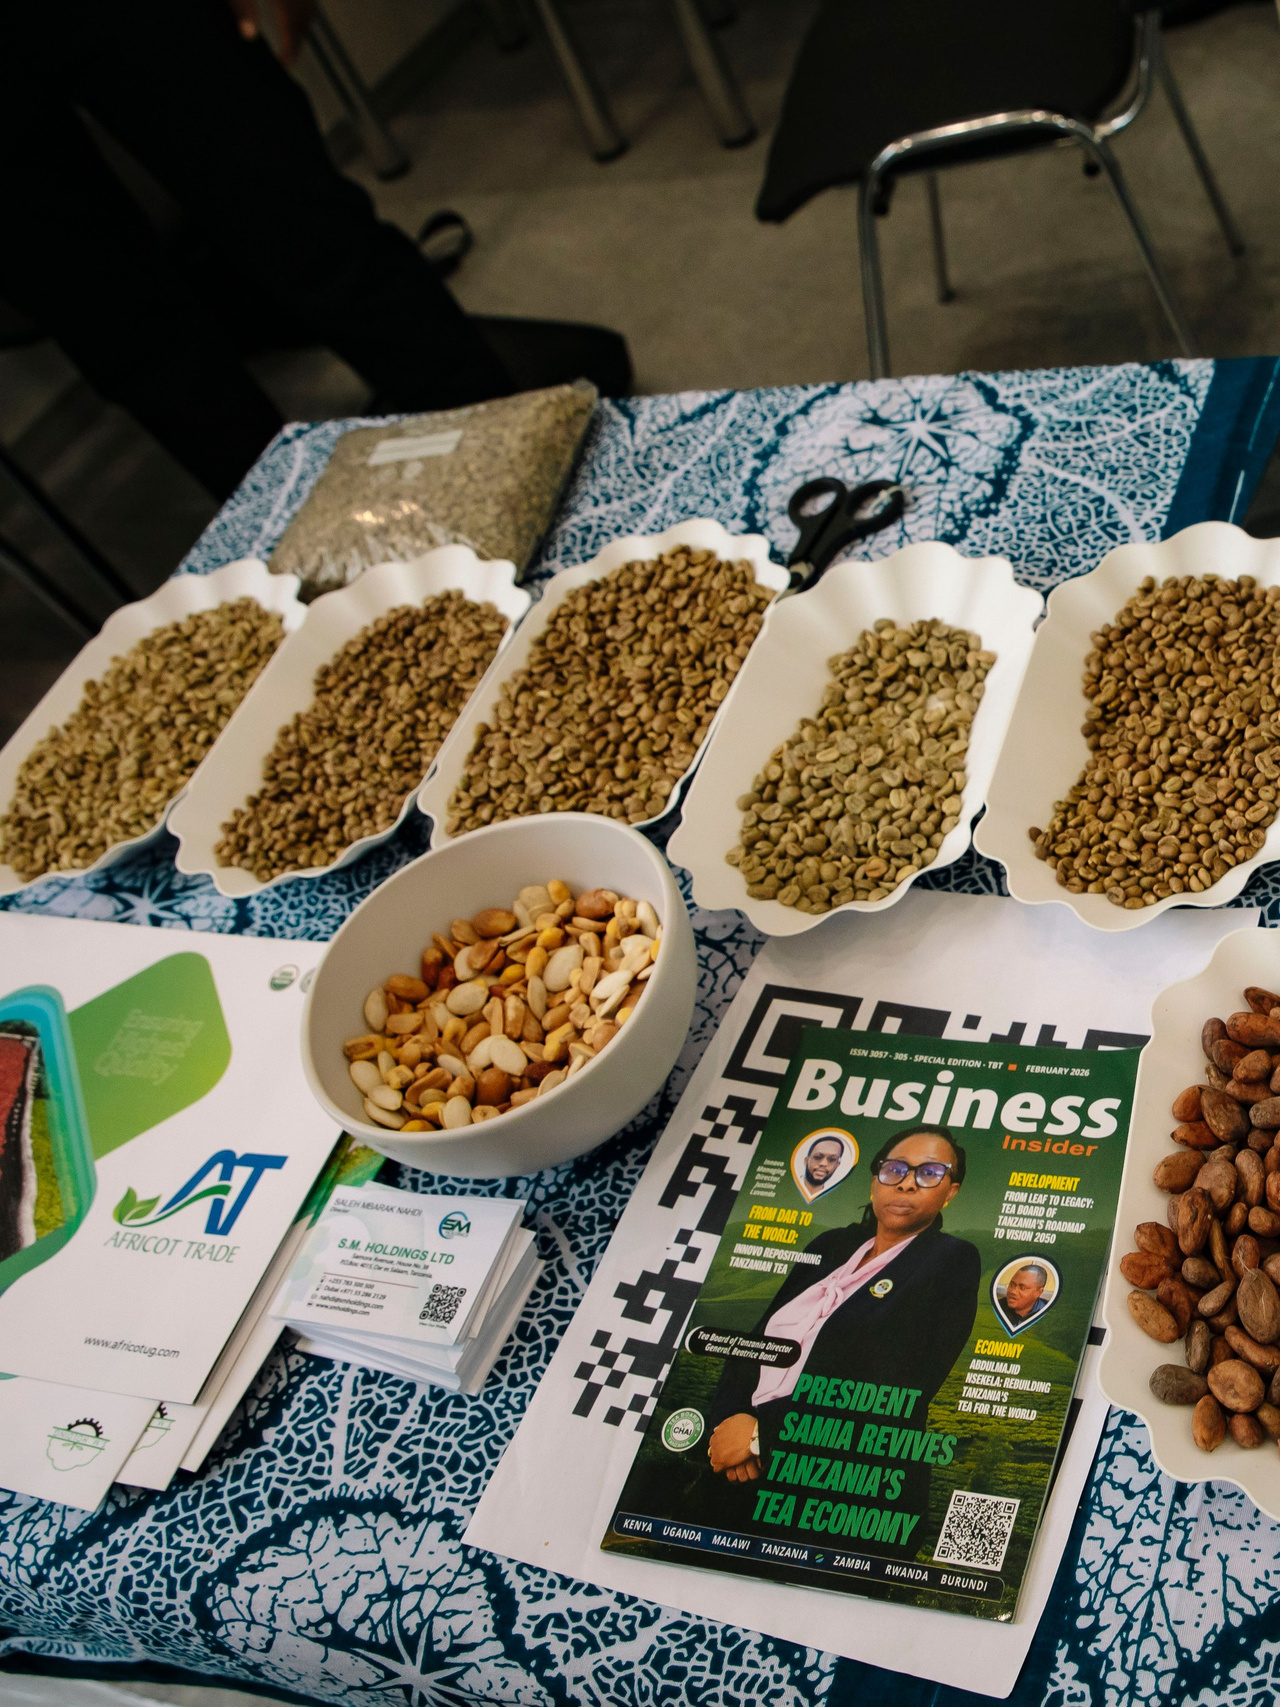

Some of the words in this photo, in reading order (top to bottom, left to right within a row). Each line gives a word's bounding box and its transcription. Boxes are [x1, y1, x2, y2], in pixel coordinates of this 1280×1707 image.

[850, 1048, 868, 1058] ISSN
[869, 1050, 888, 1060] 3057
[894, 1052, 908, 1061] 305
[913, 1054, 945, 1065] SPECIAL
[947, 1057, 981, 1068] EDITION
[987, 1060, 1003, 1070] TBT
[1025, 1064, 1069, 1076] FEBRUARY
[1070, 1067, 1090, 1077] 2026
[786, 1058, 1122, 1139] Business
[1002, 1135, 1098, 1157] Insider
[1008, 1171, 1081, 1192] DEVELOPMENT
[1004, 1190, 1028, 1203] FROM
[1028, 1193, 1048, 1205] LEAF
[1049, 1195, 1060, 1206] TO
[1060, 1196, 1094, 1209] LEGACY:
[749, 1205, 776, 1222] FROM
[776, 1208, 796, 1225] DAR
[799, 1211, 813, 1226] TO
[1001, 1203, 1016, 1214] TEA
[1017, 1205, 1045, 1217] BOARD
[1046, 1207, 1058, 1219] OF
[442, 1218, 471, 1234] SM
[742, 1223, 761, 1240] THE
[762, 1226, 799, 1245] WORLD:
[997, 1215, 1044, 1230] TANZANIA'S
[1045, 1220, 1086, 1234] ROADMAP
[994, 1228, 1005, 1239] TO
[1005, 1229, 1033, 1242] VISION
[1033, 1233, 1057, 1244] 2050
[103, 1230, 183, 1255] AFRICOT
[183, 1240, 240, 1264] TRADE
[338, 1238, 361, 1251] S.M.
[364, 1242, 428, 1261] HOLDINGS
[430, 1252, 455, 1265] LTD
[733, 1243, 763, 1257] INNOVO
[763, 1246, 822, 1265] REPOSITIONING
[729, 1256, 773, 1273] TANZANIAN
[773, 1262, 788, 1275] TEA
[84, 1336, 180, 1359] www.africotug.com
[698, 1331, 709, 1341] Tea
[709, 1333, 730, 1344] Board
[730, 1335, 738, 1346] of
[737, 1337, 766, 1350] Tanzania
[766, 1341, 793, 1353] Director
[705, 1343, 731, 1356] General,
[731, 1347, 759, 1359] Beatrice
[974, 1339, 1024, 1359] ECONOMY
[969, 1359, 1021, 1375] ABDULMAJID
[965, 1372, 1003, 1387] NSEKELA:
[1003, 1377, 1051, 1393] REBUILDING
[792, 1373, 922, 1419] PRESIDENT
[962, 1386, 1009, 1403] TANZANIA'S
[957, 1400, 973, 1412] TEA
[973, 1402, 991, 1415] FOR
[991, 1404, 1007, 1416] THE
[1008, 1407, 1037, 1421] WORLD
[673, 1426, 693, 1436] CHAI
[779, 1411, 854, 1451] SAMIA
[856, 1423, 958, 1465] REVIVES
[766, 1450, 905, 1500] TANZANIA'S
[752, 1490, 796, 1527] TEA
[797, 1498, 920, 1546] ECONOMY
[623, 1518, 652, 1533] KENYA
[662, 1525, 701, 1542] UGANDA
[711, 1534, 751, 1551] MALAWI
[761, 1543, 808, 1561] TANZANIA
[833, 1555, 871, 1572] ZAMBIA
[885, 1564, 929, 1582] RWANDA
[940, 1574, 988, 1592] BURUNDI
